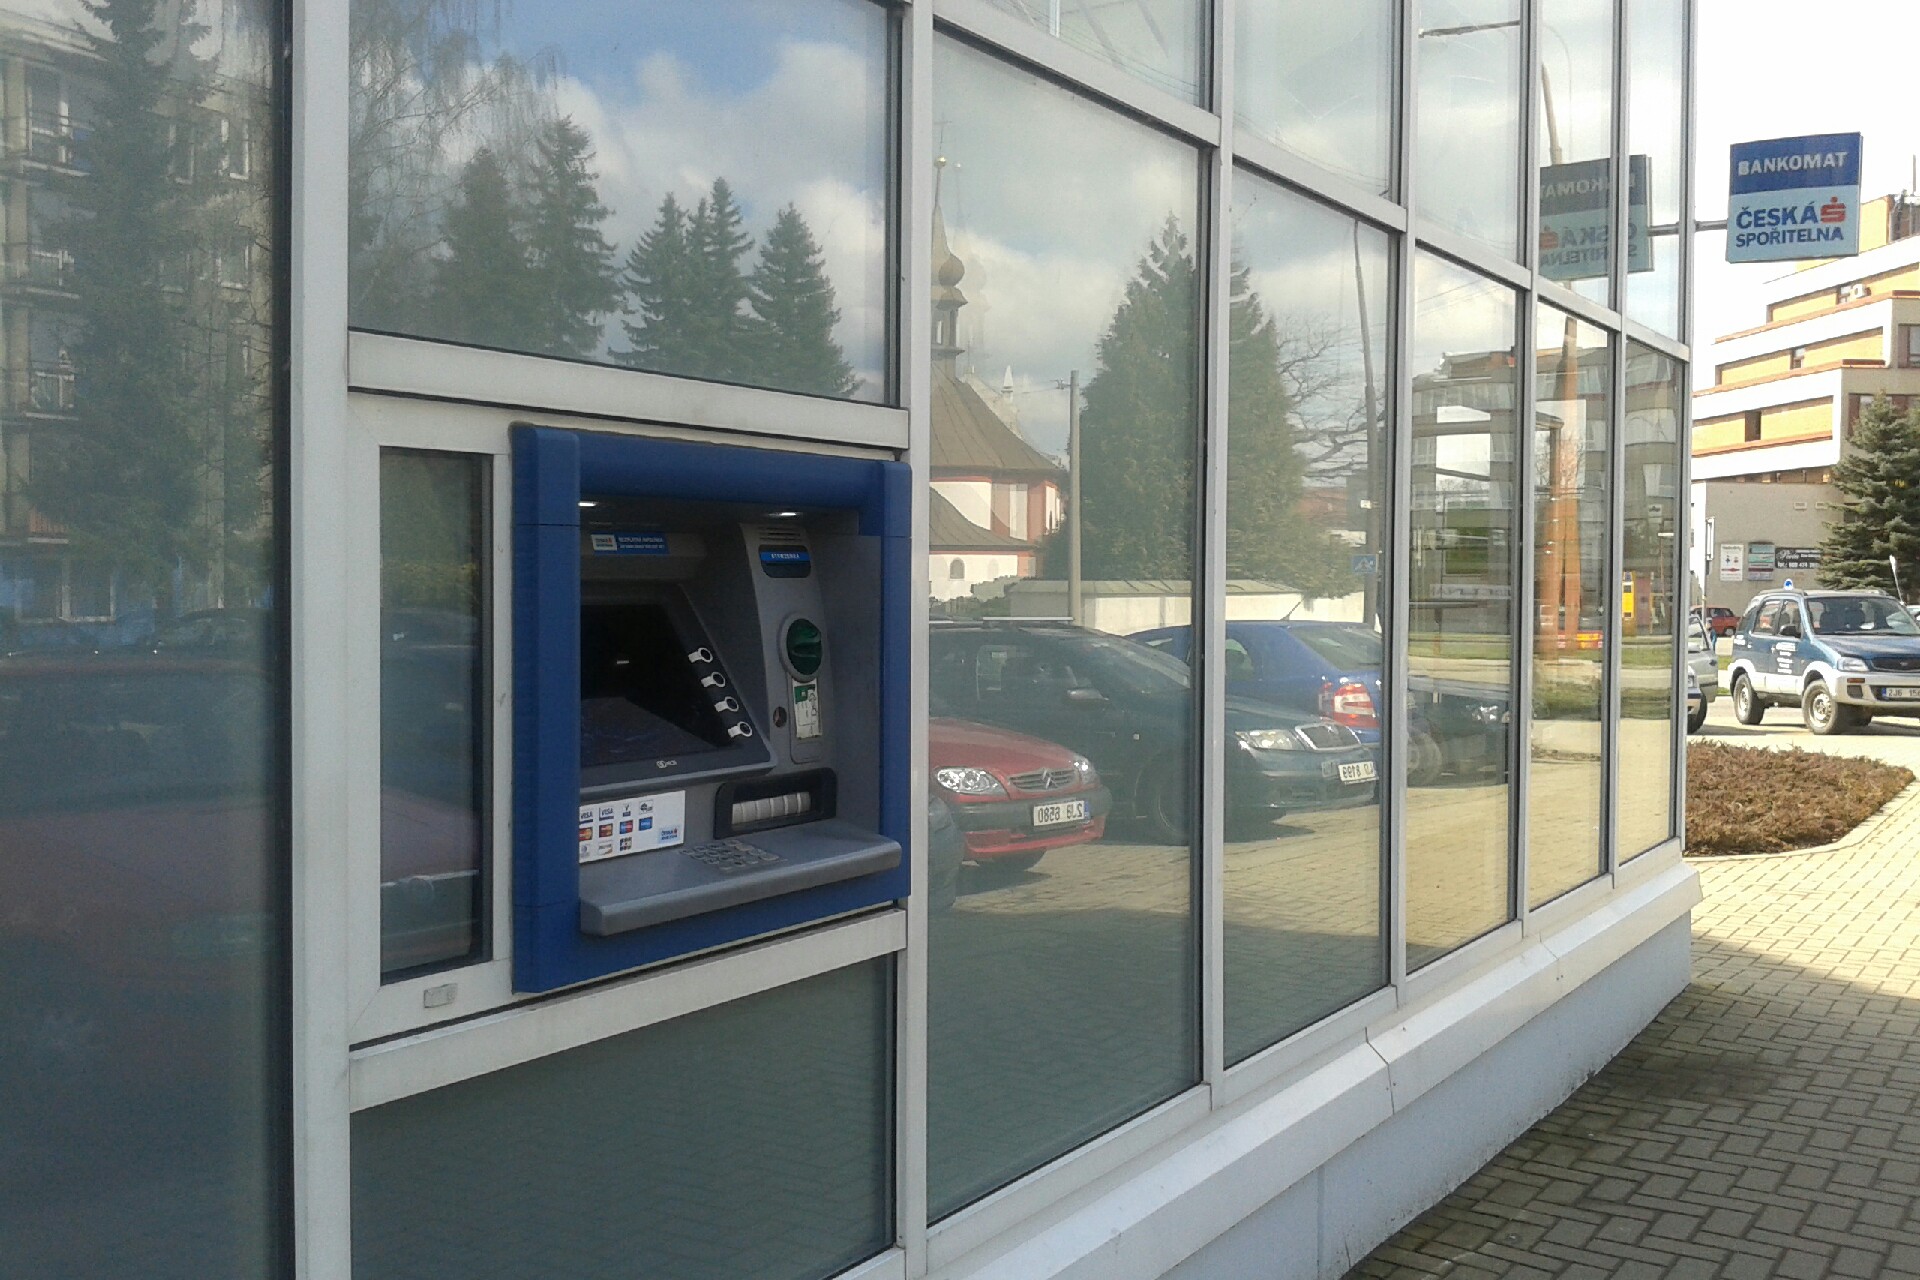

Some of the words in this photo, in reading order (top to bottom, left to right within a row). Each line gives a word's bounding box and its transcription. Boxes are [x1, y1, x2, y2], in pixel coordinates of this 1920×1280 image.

[1738, 151, 1848, 176] BANKOMAT
[1736, 201, 1819, 229] ČESKÁ
[1736, 226, 1845, 248] SPOŘITELNA
[601, 807, 613, 816] VISA
